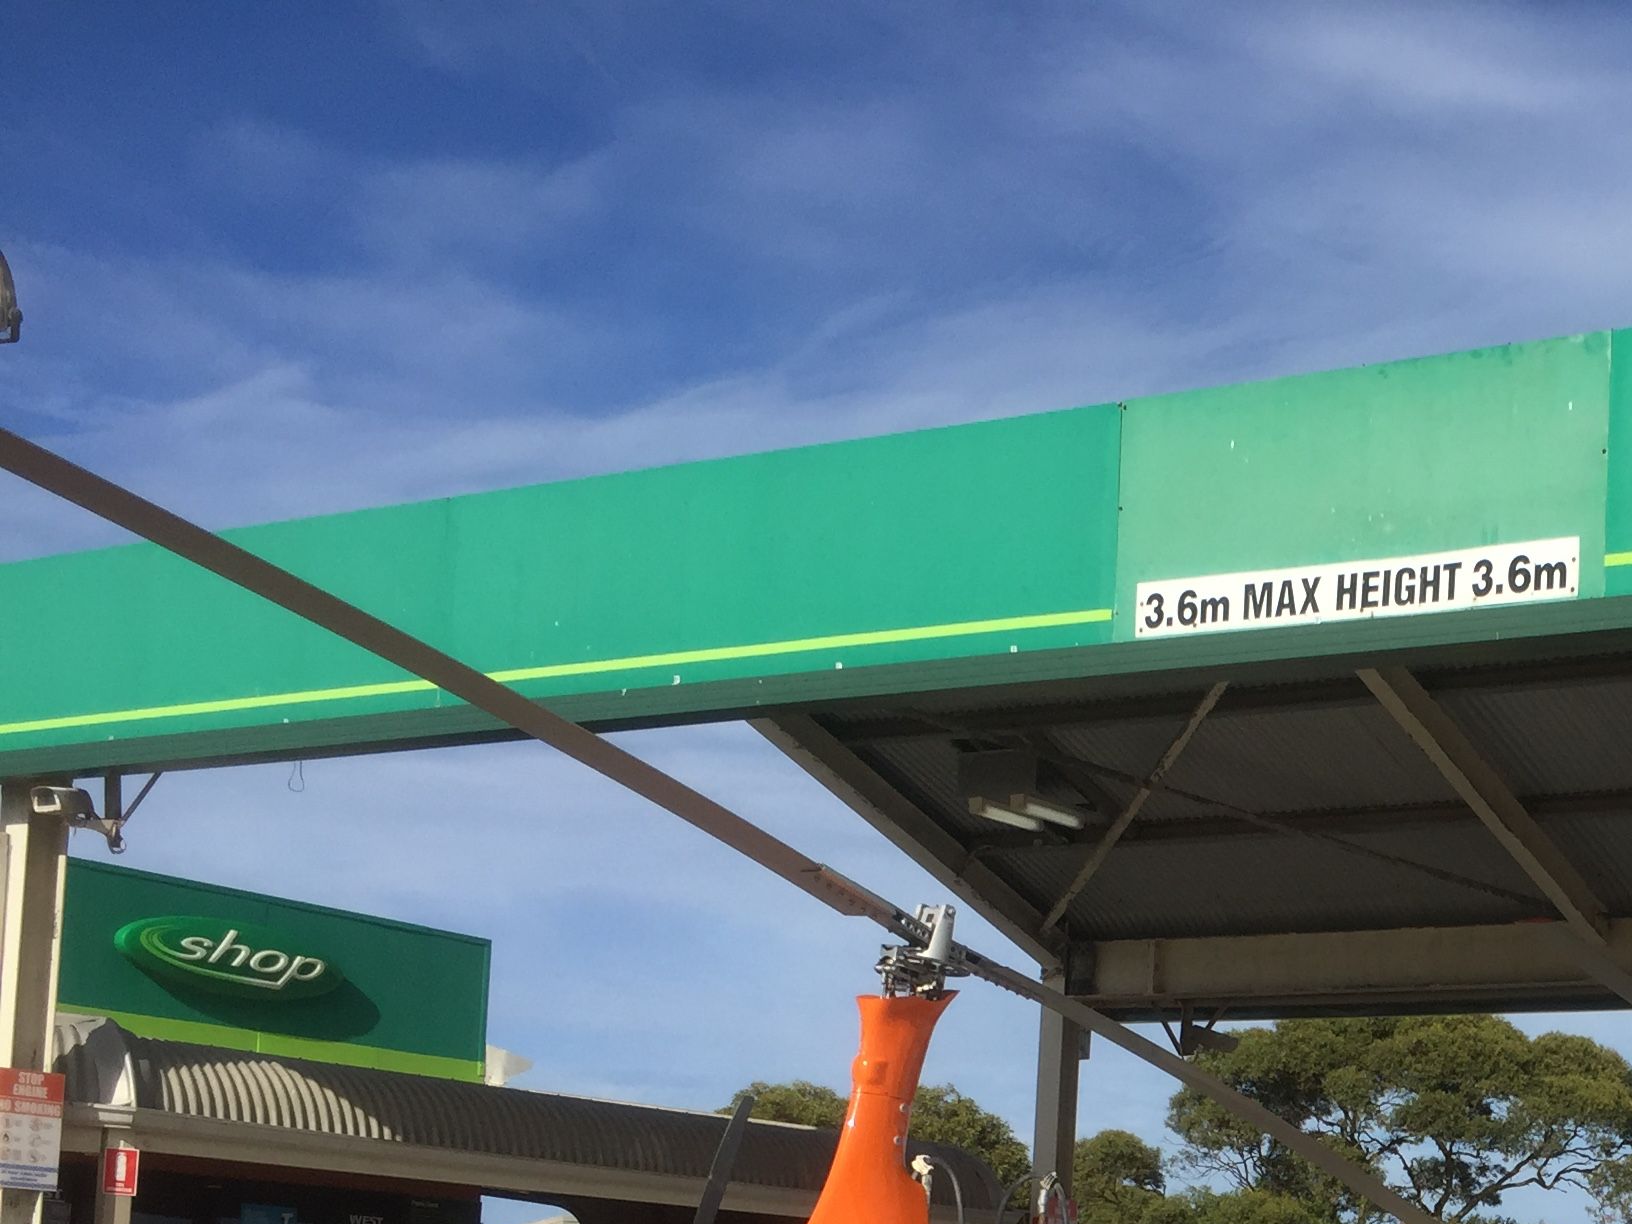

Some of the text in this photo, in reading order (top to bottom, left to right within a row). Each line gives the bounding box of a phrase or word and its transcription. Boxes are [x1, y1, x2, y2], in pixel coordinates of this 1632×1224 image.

[1143, 554, 1568, 630] 3.6m MAX HEIGHT 3.6m
[180, 929, 326, 990] shop
[18, 1071, 45, 1086] STOP
[13, 1083, 49, 1099] ENGINE
[14, 1101, 61, 1117] SMOKING
